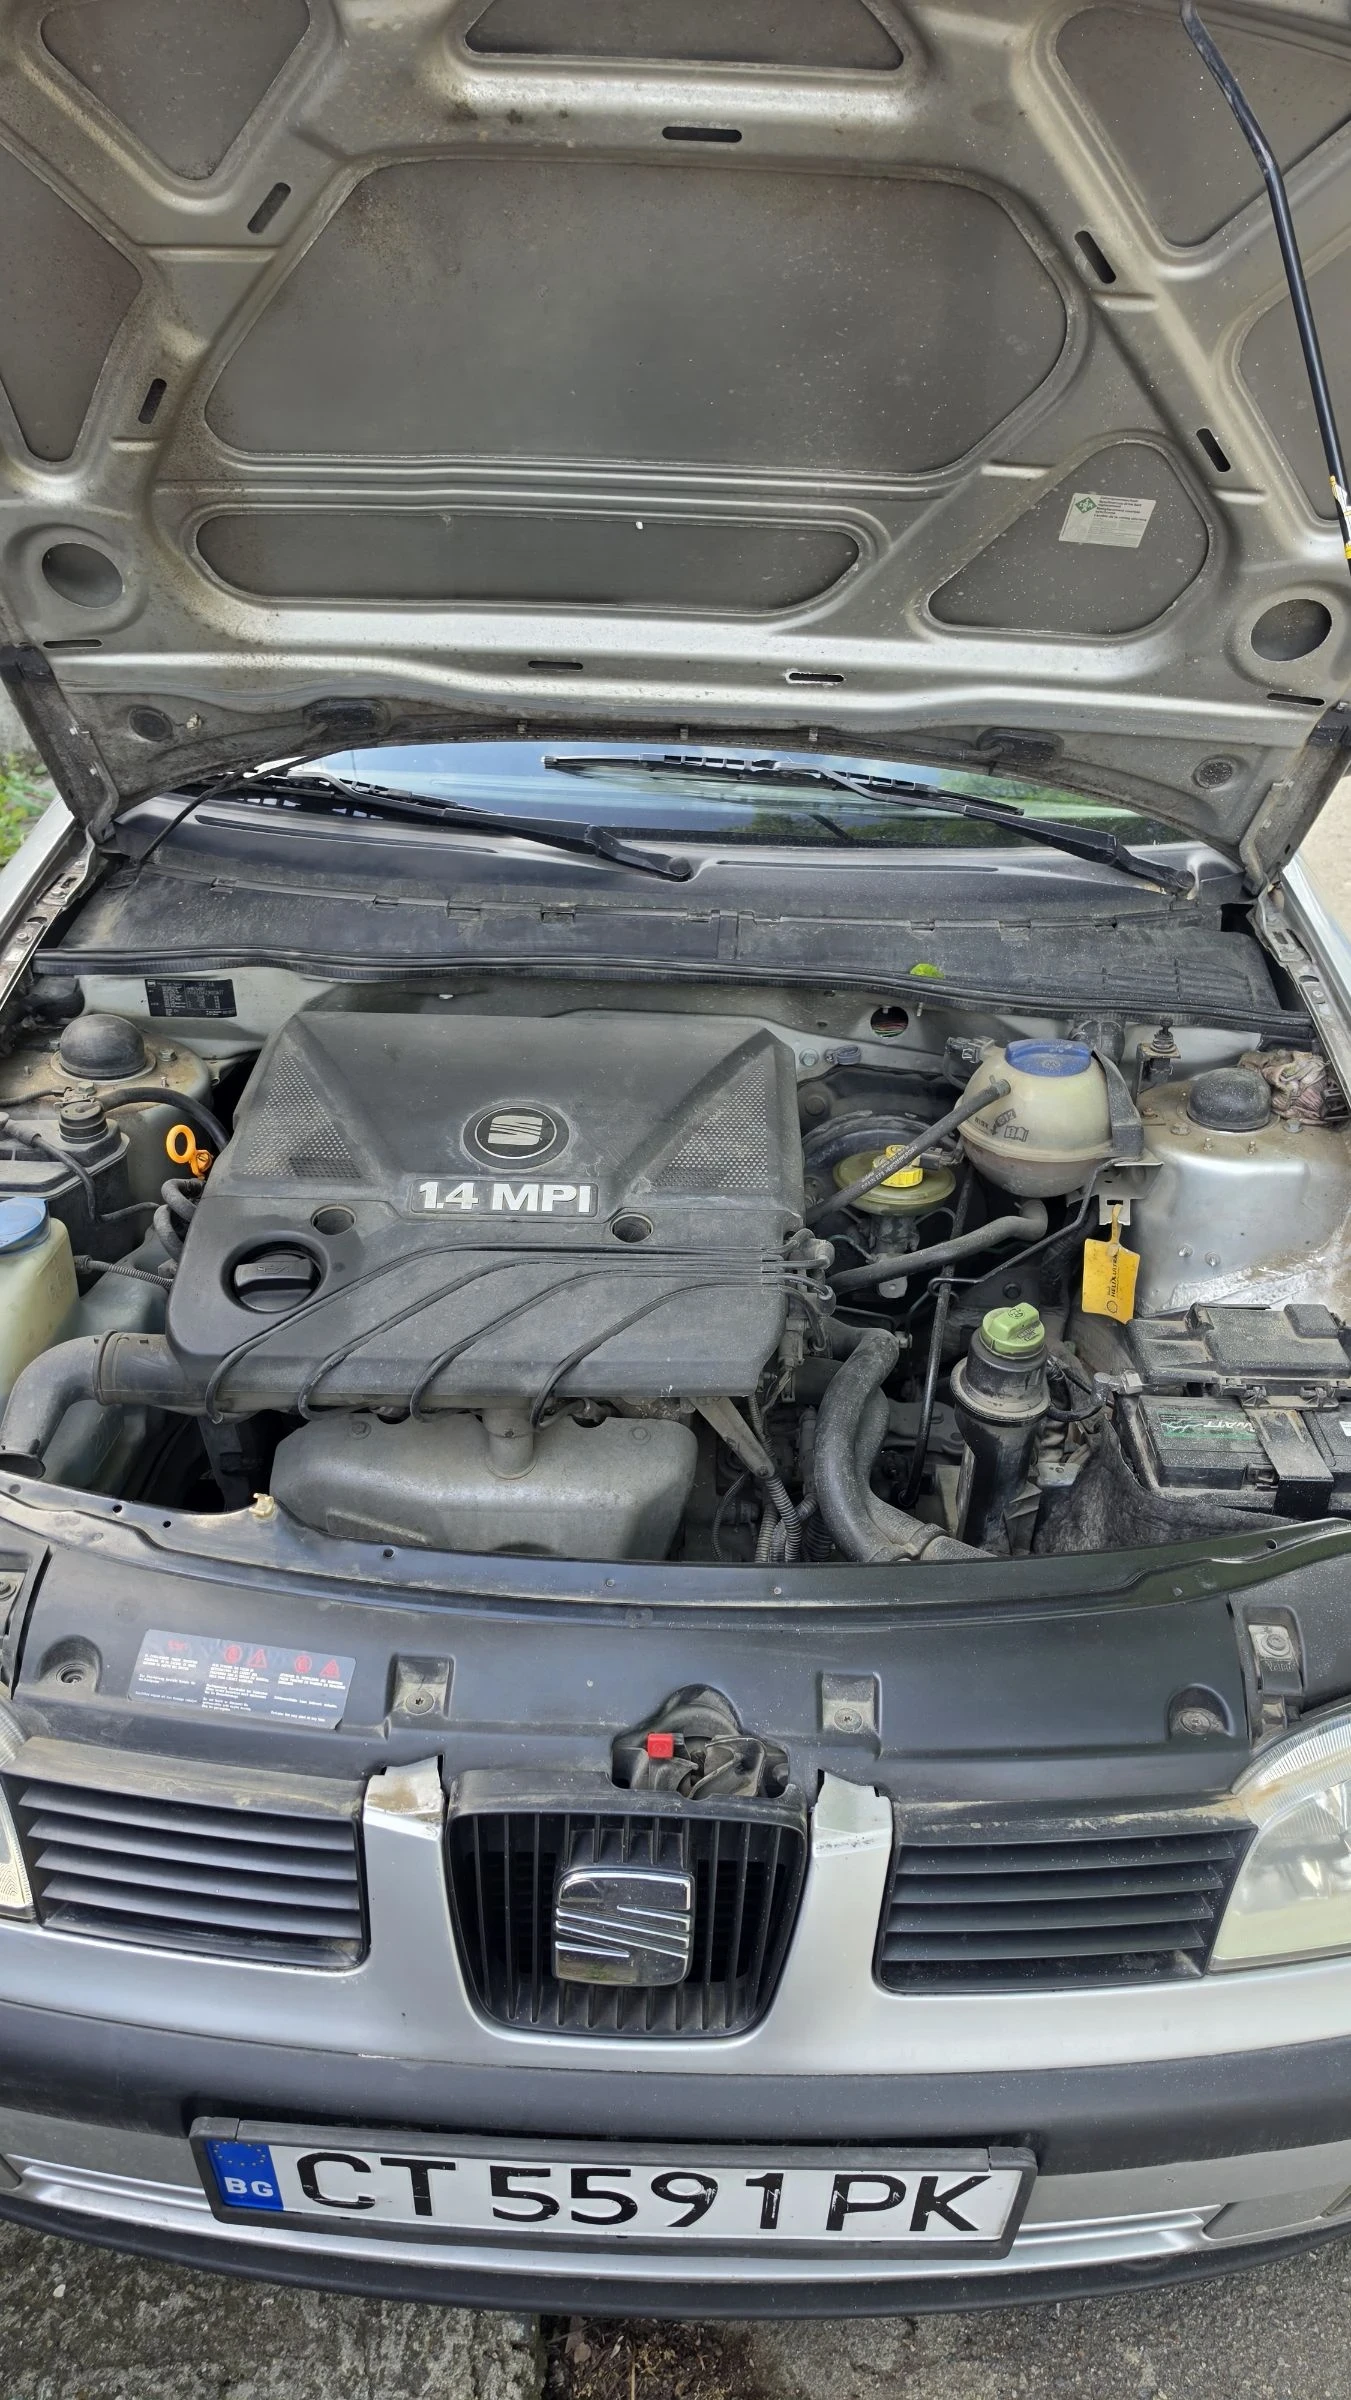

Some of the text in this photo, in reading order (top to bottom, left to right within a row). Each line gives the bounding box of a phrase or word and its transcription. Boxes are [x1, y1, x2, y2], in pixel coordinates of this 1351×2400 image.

[419, 1181, 591, 1213] 1.4 MPI
[224, 2176, 274, 2197] BG
[297, 2152, 992, 2232] CT 5591 PK
